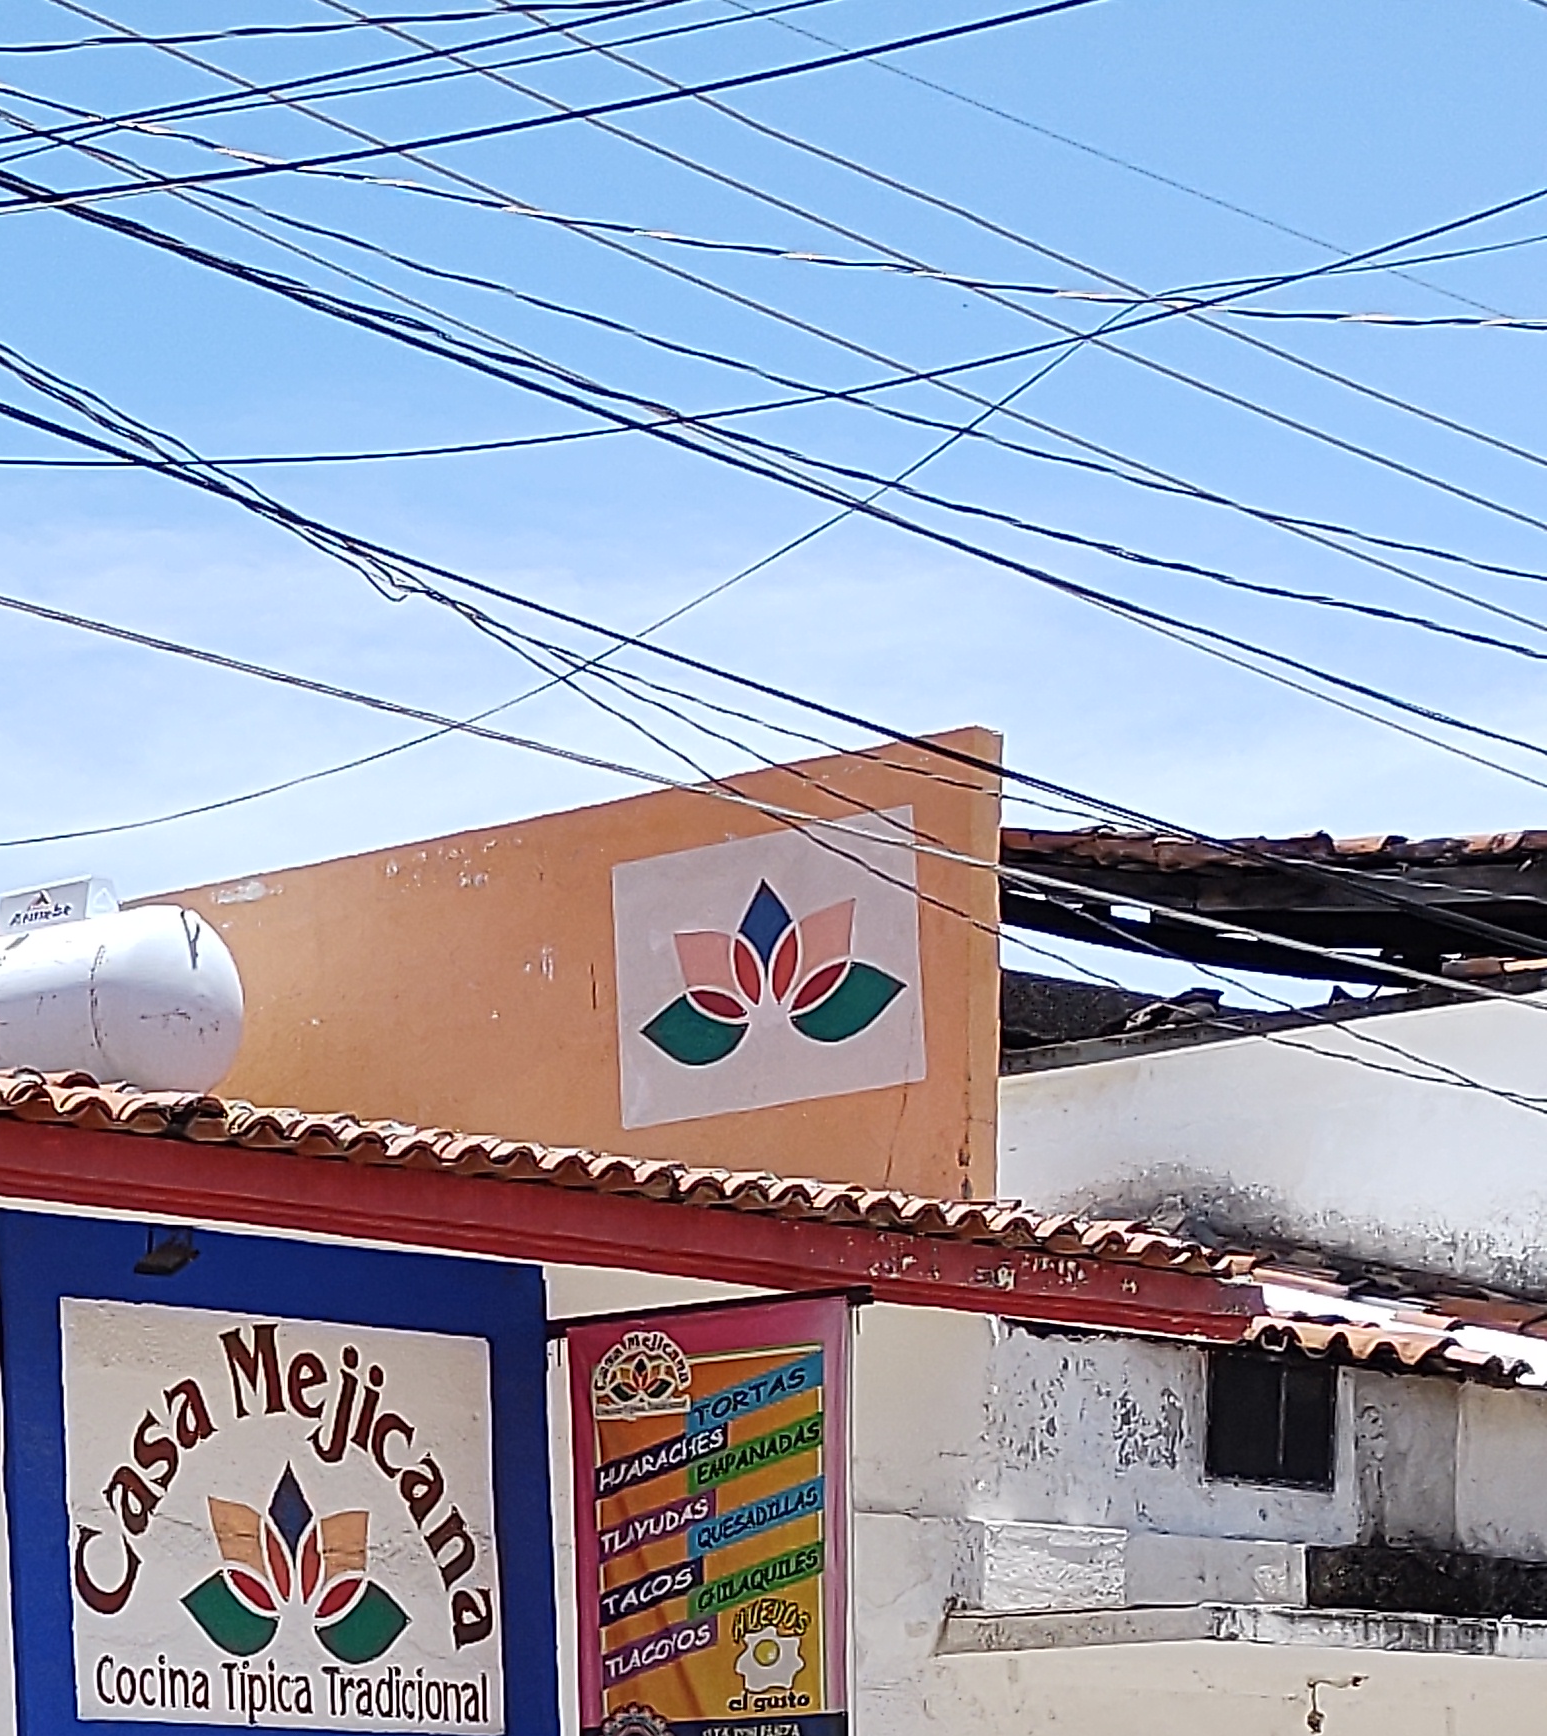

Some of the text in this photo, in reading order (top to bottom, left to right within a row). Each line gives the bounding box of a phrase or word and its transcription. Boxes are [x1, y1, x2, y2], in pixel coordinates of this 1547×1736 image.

[694, 1367, 806, 1426] TORTAS
[599, 1428, 724, 1491] HUARACHES
[697, 1421, 820, 1484] EMPANADAS
[74, 1323, 493, 1651] Casa Mejicana
[697, 1486, 818, 1549] QUESADILLAS
[601, 1496, 709, 1555] TLAYUDAS
[601, 1565, 695, 1616] TACOS
[697, 1549, 818, 1613] CHILAQUILES
[605, 1623, 712, 1678] TLACOYOS
[95, 1656, 210, 1711] Cocina
[322, 1666, 490, 1724] Tradicional
[754, 1691, 810, 1712] gusto
